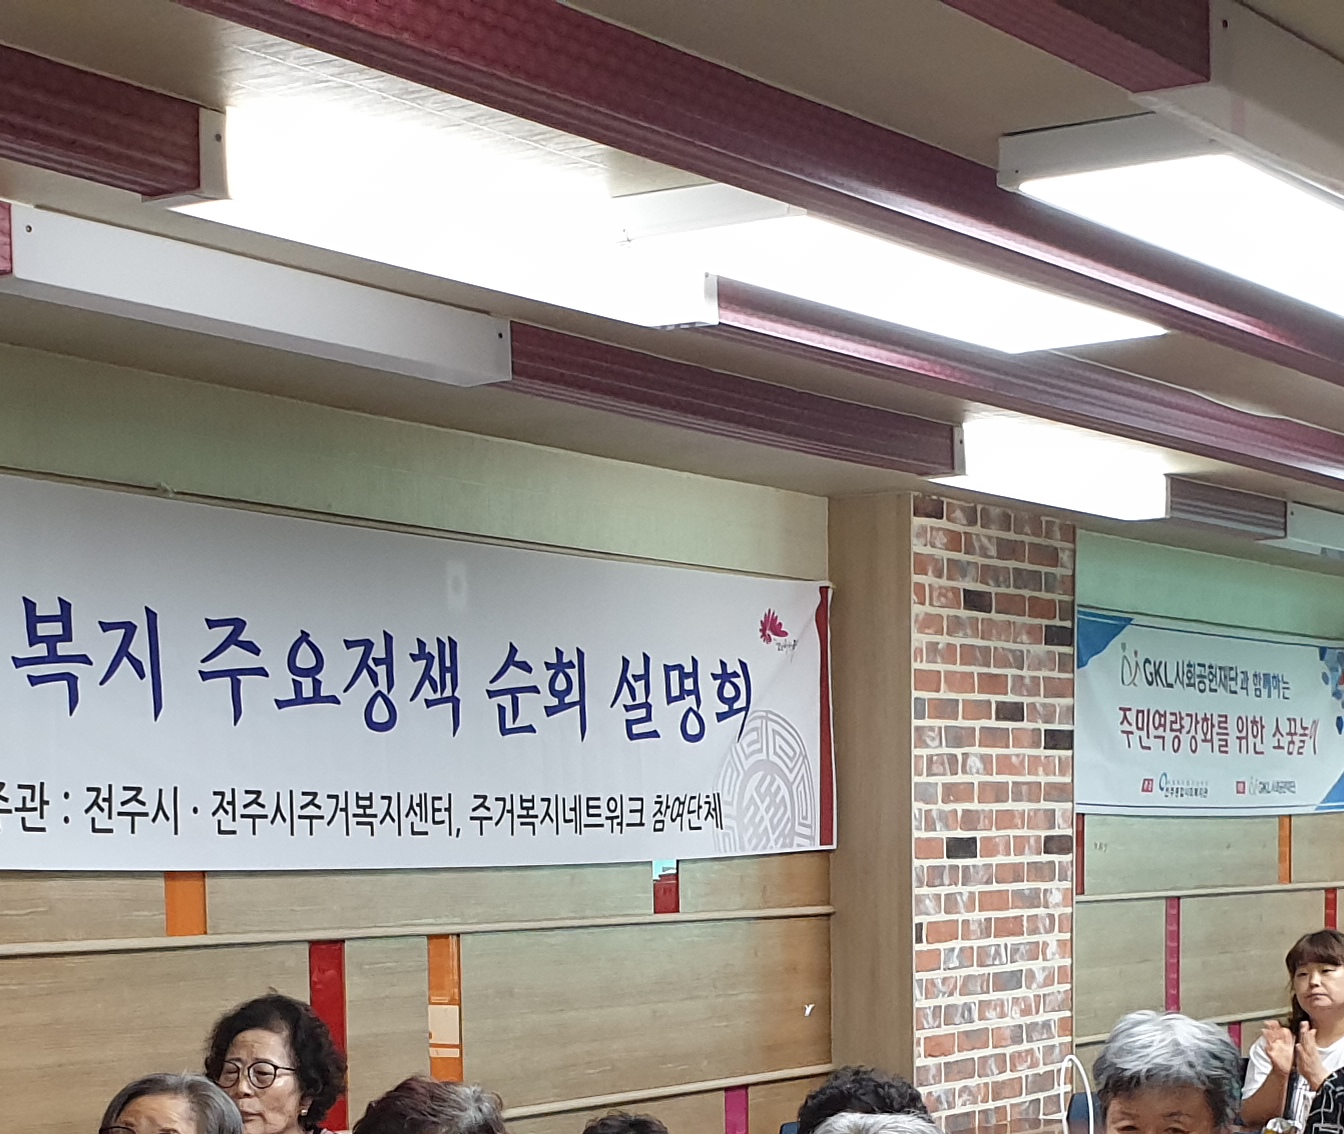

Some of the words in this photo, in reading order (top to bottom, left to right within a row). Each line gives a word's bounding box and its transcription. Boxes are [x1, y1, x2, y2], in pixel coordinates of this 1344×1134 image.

[197, 616, 461, 737] 주요정책
[484, 640, 590, 742] 순회
[609, 650, 753, 744] 설명회
[1253, 671, 1291, 700] 함께하는
[1118, 706, 1230, 755] 주민역량강화를
[1235, 715, 1266, 755] 위한
[62, 790, 71, 826] :
[84, 783, 179, 836] 전주시
[211, 787, 462, 839] 전주시주거복지센터,
[469, 792, 646, 837] 주거복지네트워크
[652, 792, 724, 833] 참여단체
